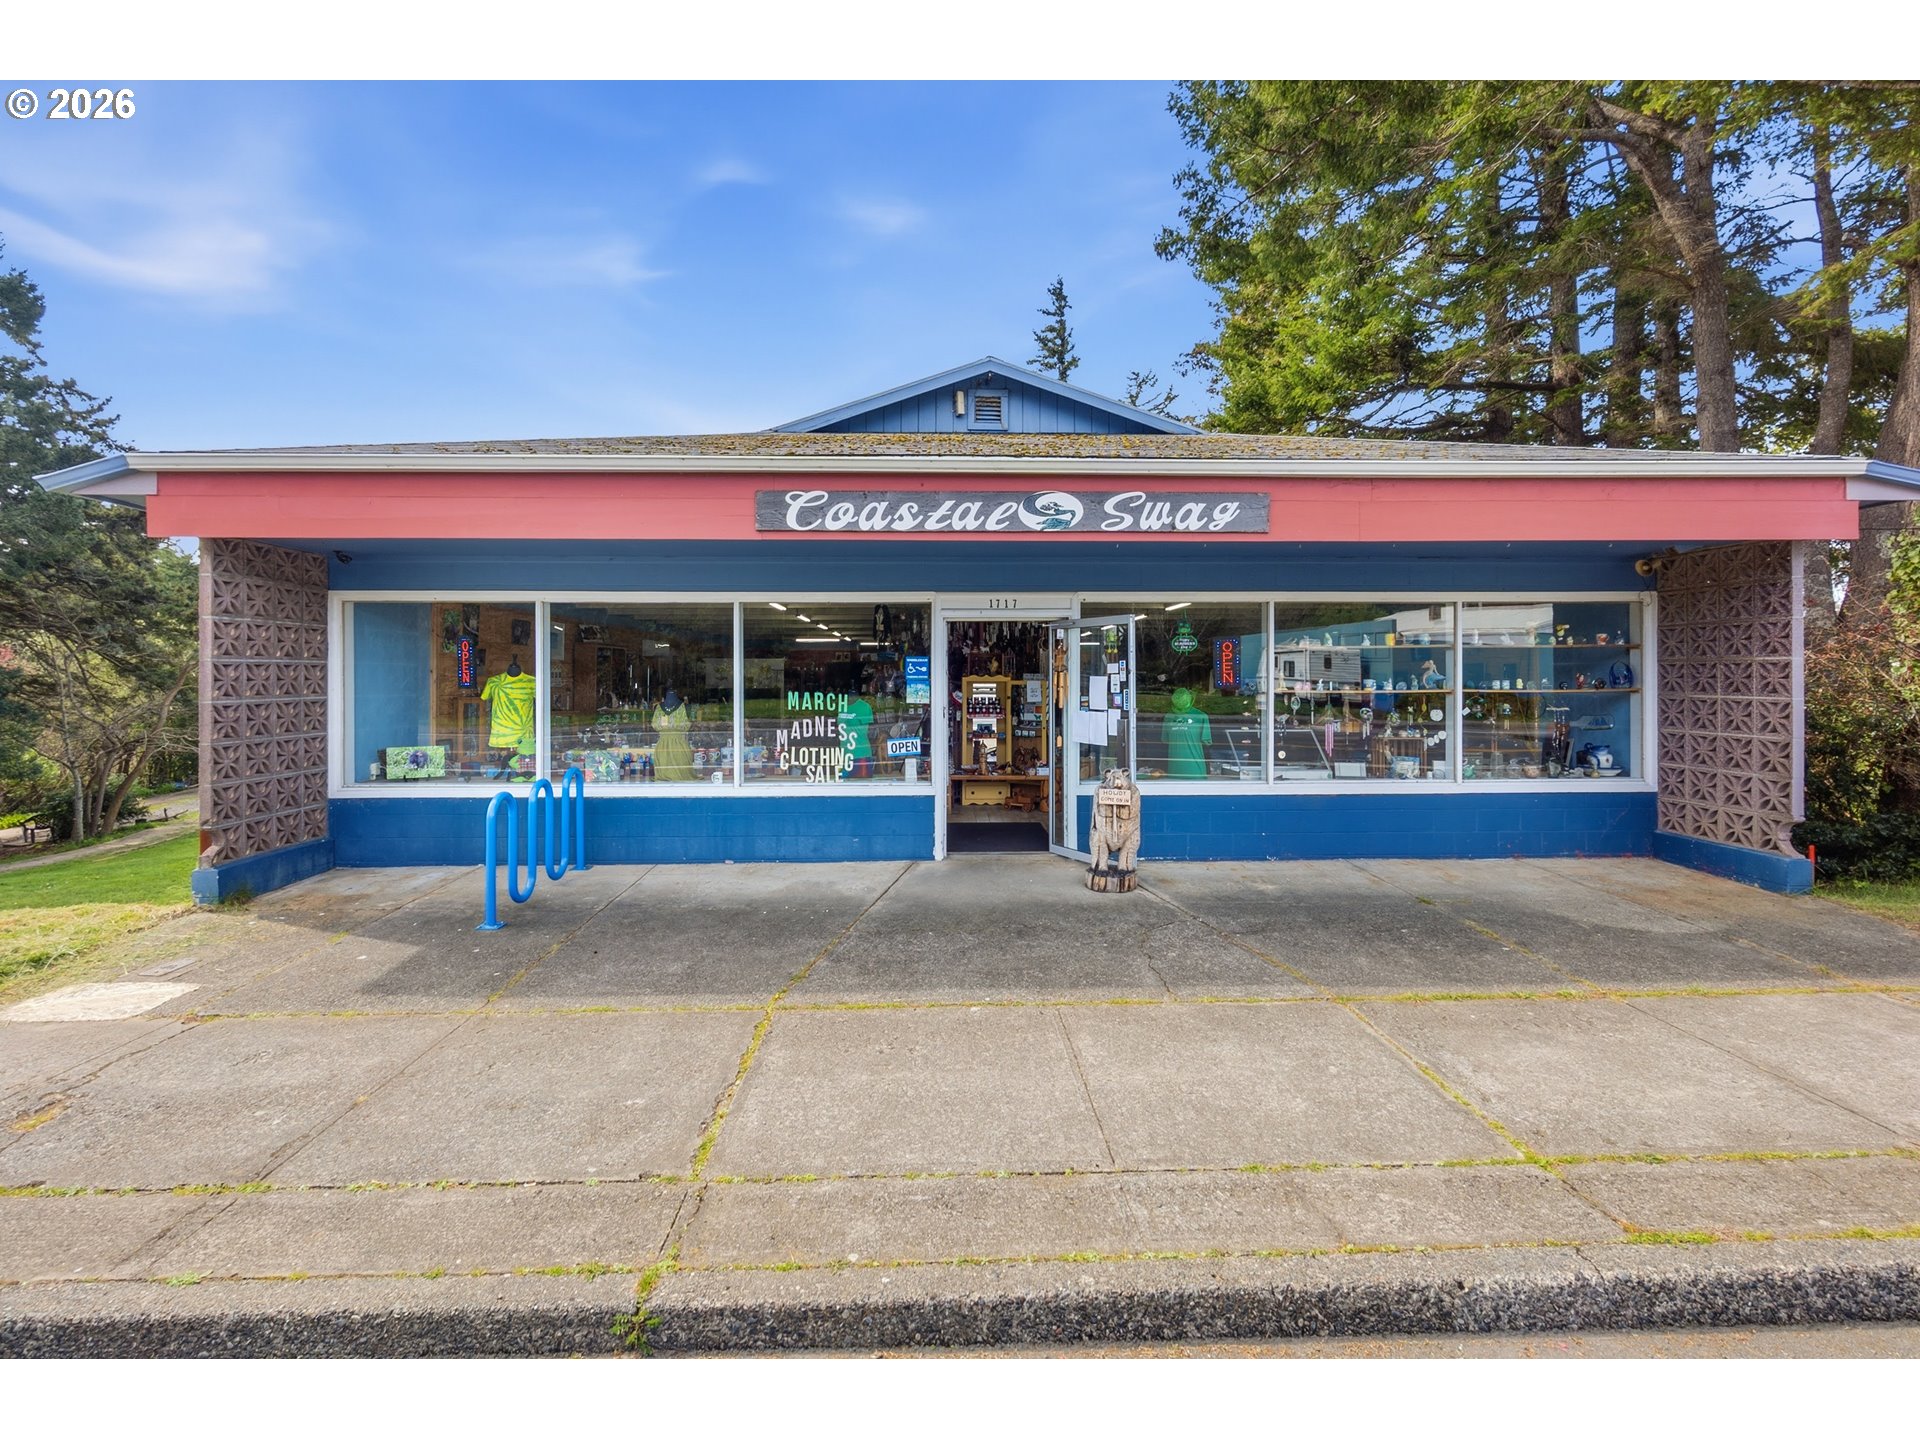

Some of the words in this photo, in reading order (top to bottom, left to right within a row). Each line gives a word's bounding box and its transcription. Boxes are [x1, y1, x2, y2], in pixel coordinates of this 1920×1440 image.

[1100, 491, 1241, 531] Swag
[989, 599, 1017, 609] 1717
[461, 641, 470, 683] OPEN
[1222, 642, 1233, 683] OPEN
[787, 691, 849, 713] MARCH
[776, 715, 858, 751] MADNESS
[780, 746, 854, 772] CLOTHING
[890, 741, 918, 754] OPEN
[805, 765, 844, 783] SALE
